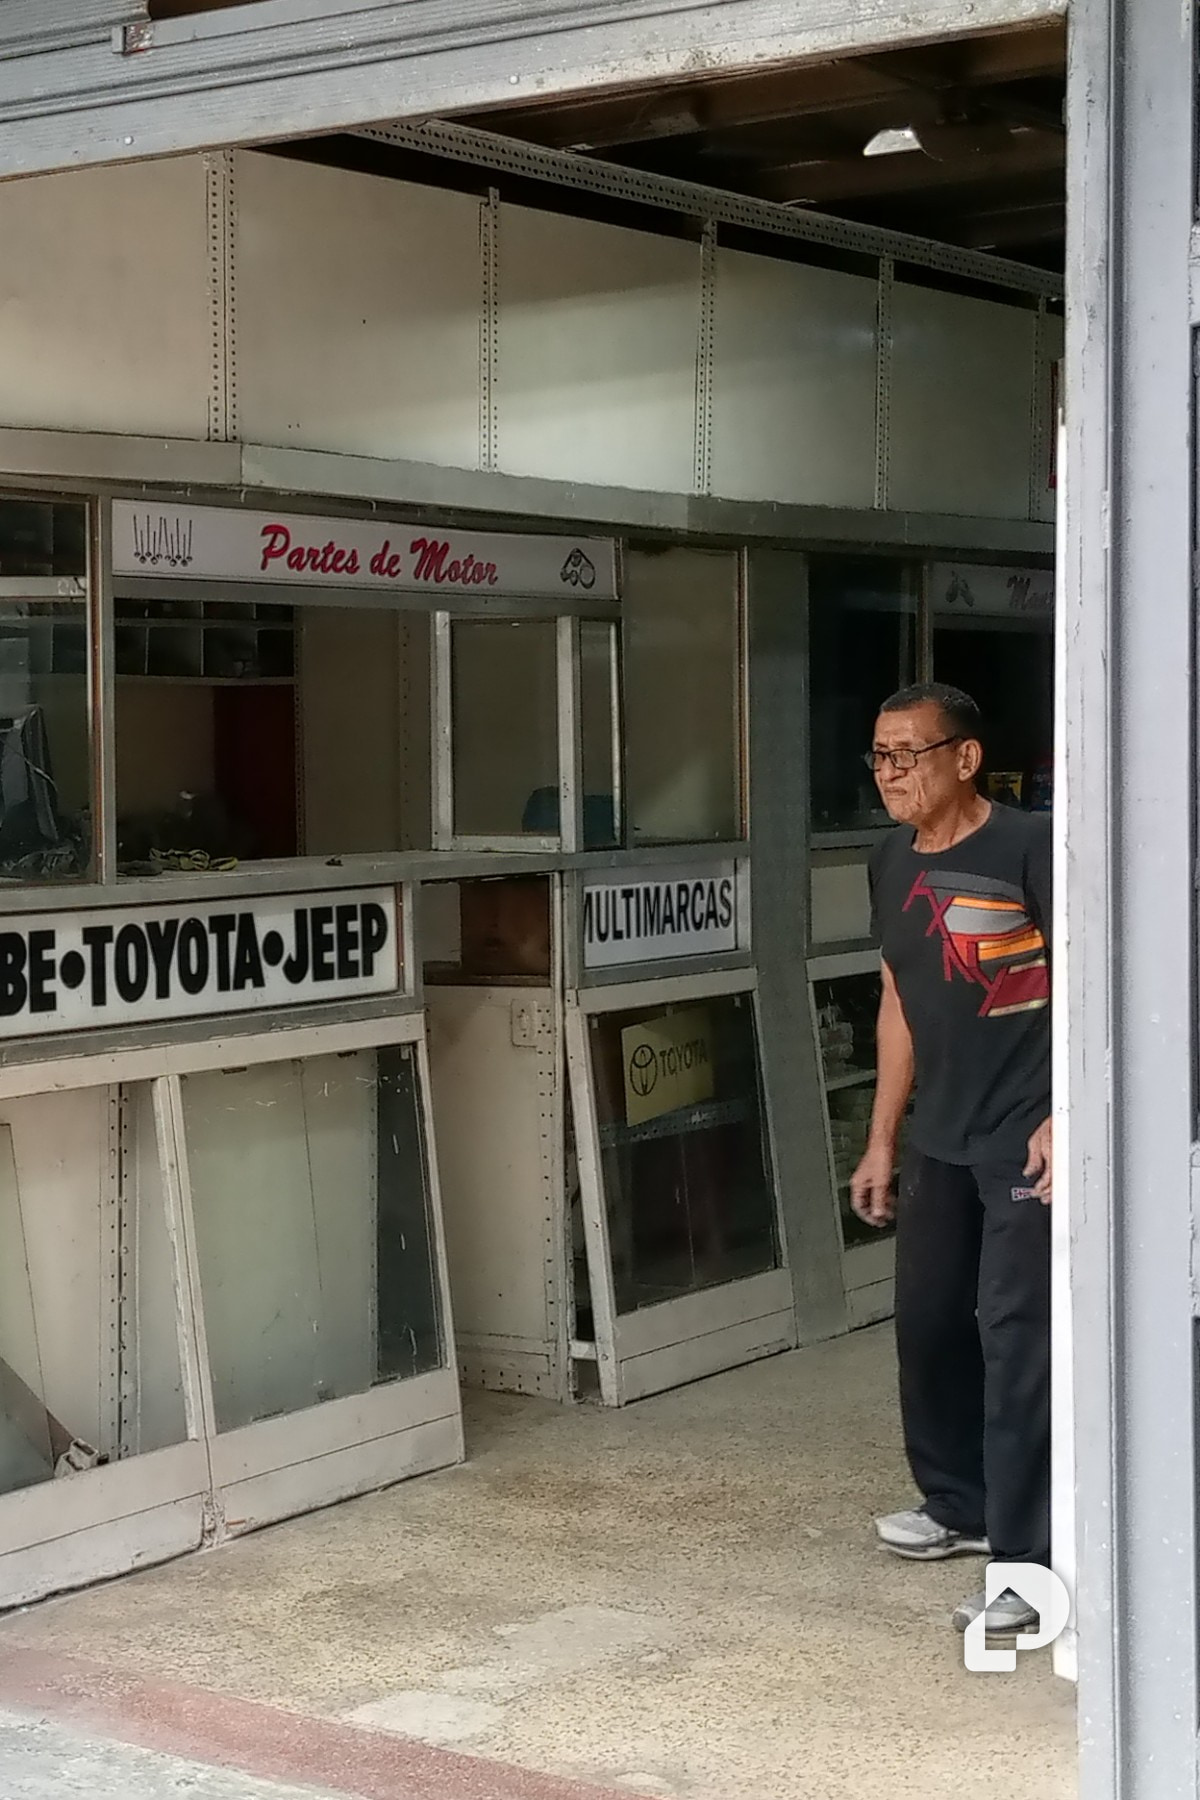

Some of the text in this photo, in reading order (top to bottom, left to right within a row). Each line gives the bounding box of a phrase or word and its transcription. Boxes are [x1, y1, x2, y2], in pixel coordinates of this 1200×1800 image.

[260, 524, 499, 586] Partes de Motor
[82, 911, 266, 1007] TOYOTA
[282, 902, 389, 985] JEEP
[659, 1038, 709, 1077] TOYOTA
